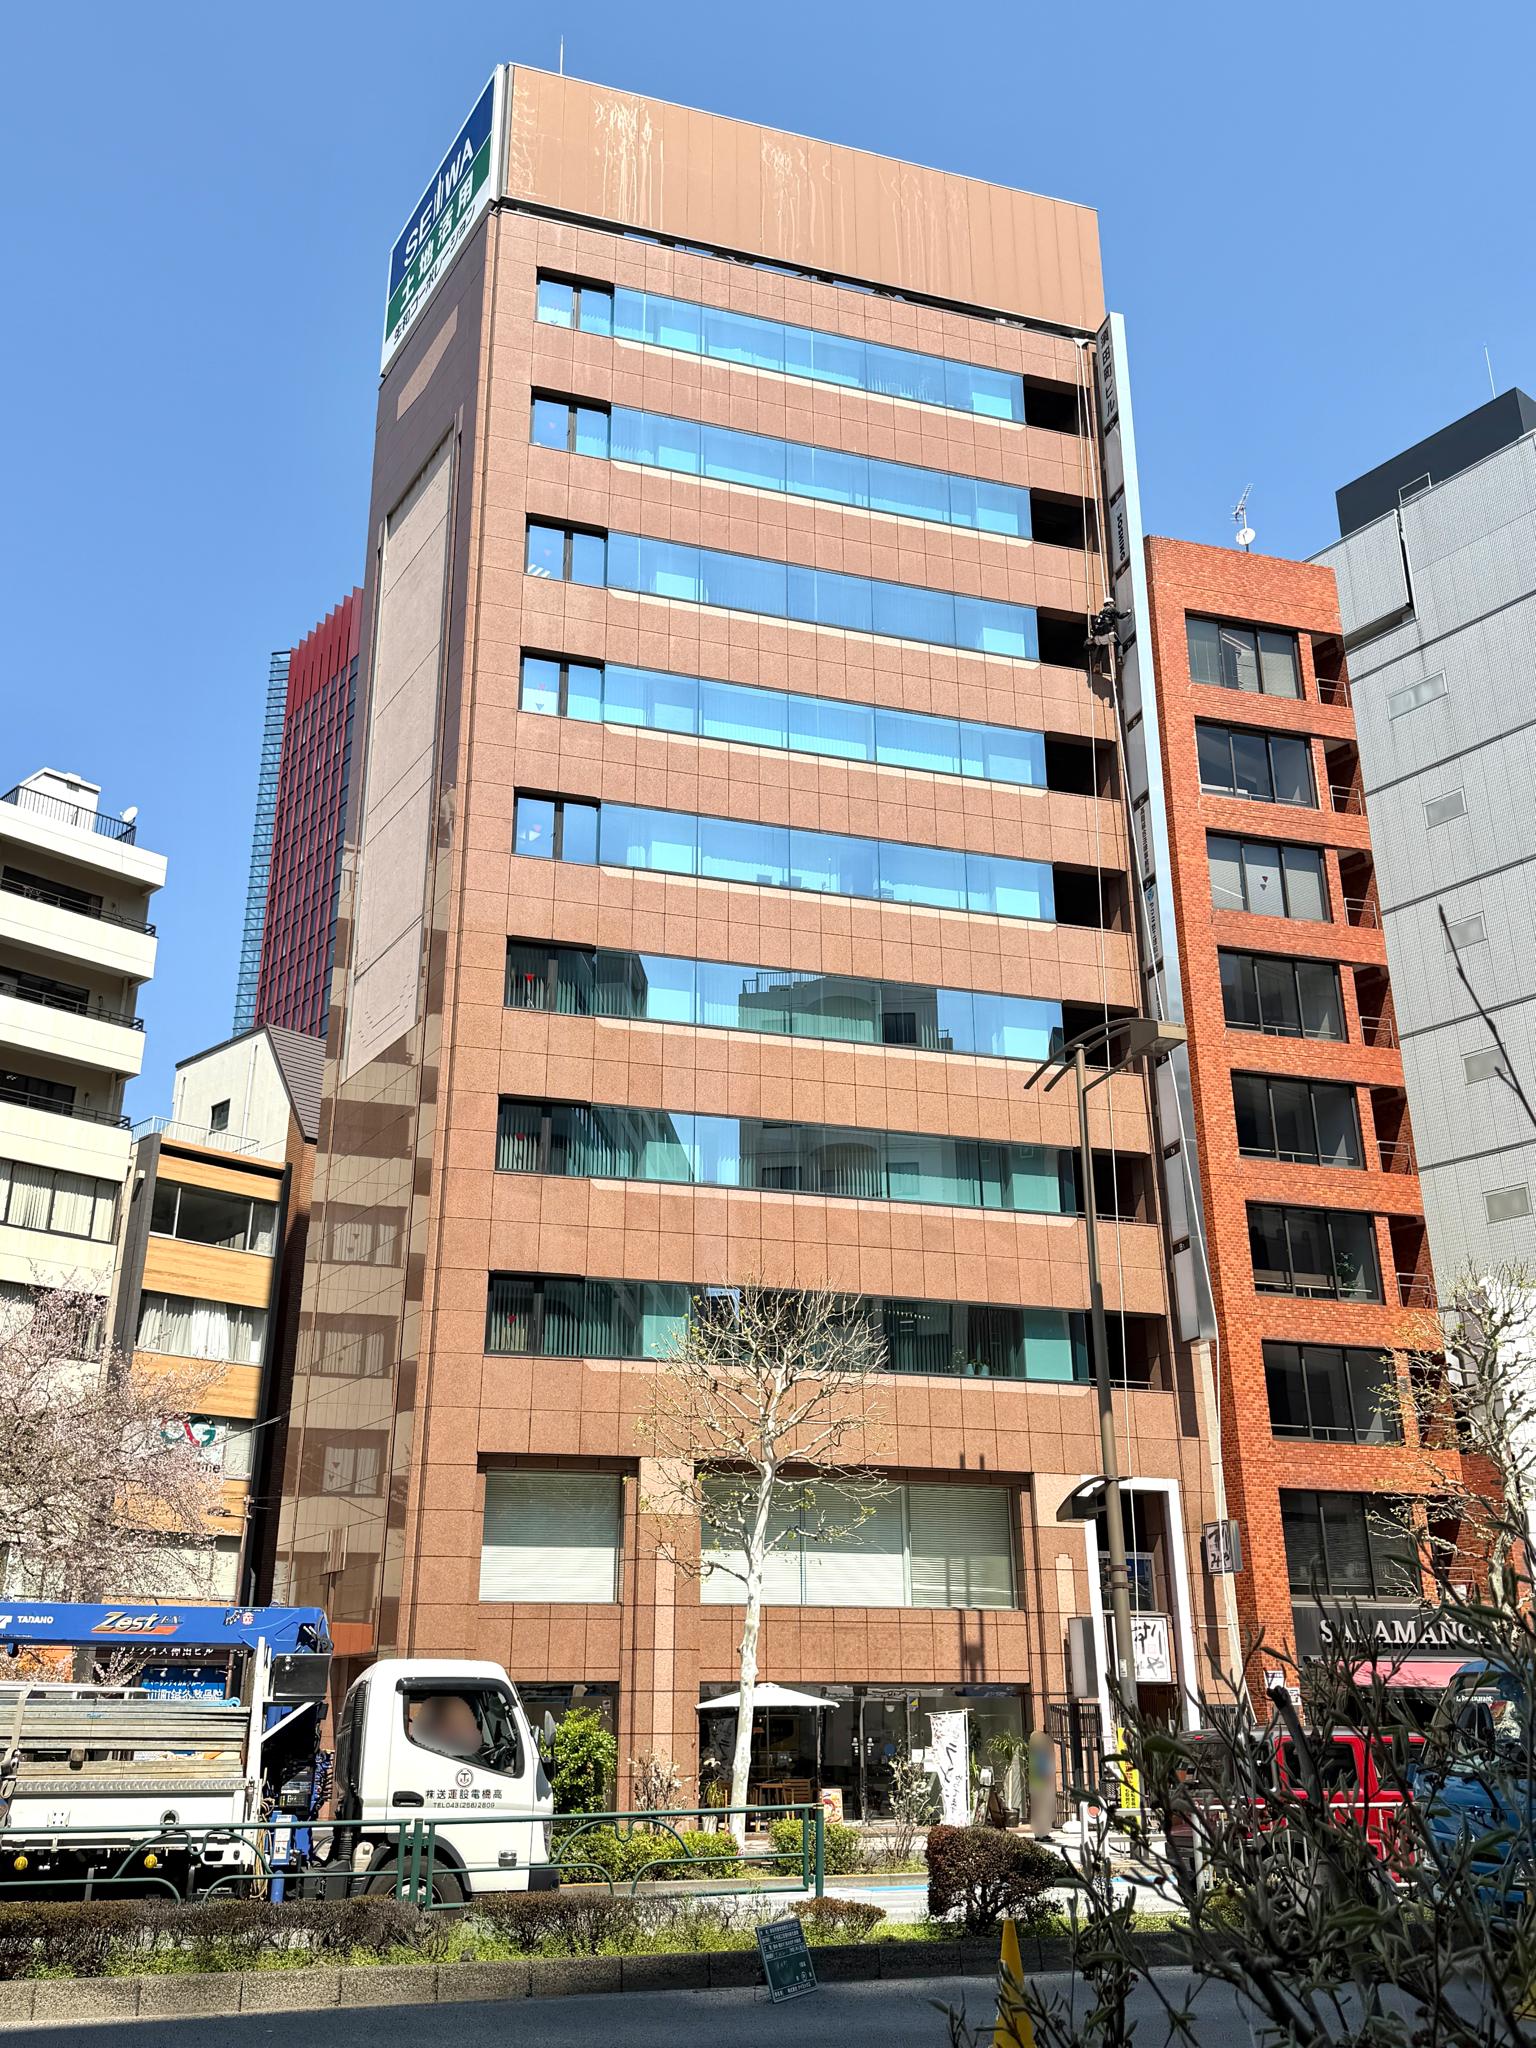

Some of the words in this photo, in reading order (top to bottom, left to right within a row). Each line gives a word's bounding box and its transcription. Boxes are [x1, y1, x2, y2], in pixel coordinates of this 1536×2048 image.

[400, 169, 474, 309] 土地活用
[403, 137, 474, 268] SEIWA
[17, 1616, 54, 1624] TADANO
[92, 1611, 160, 1632] Zest
